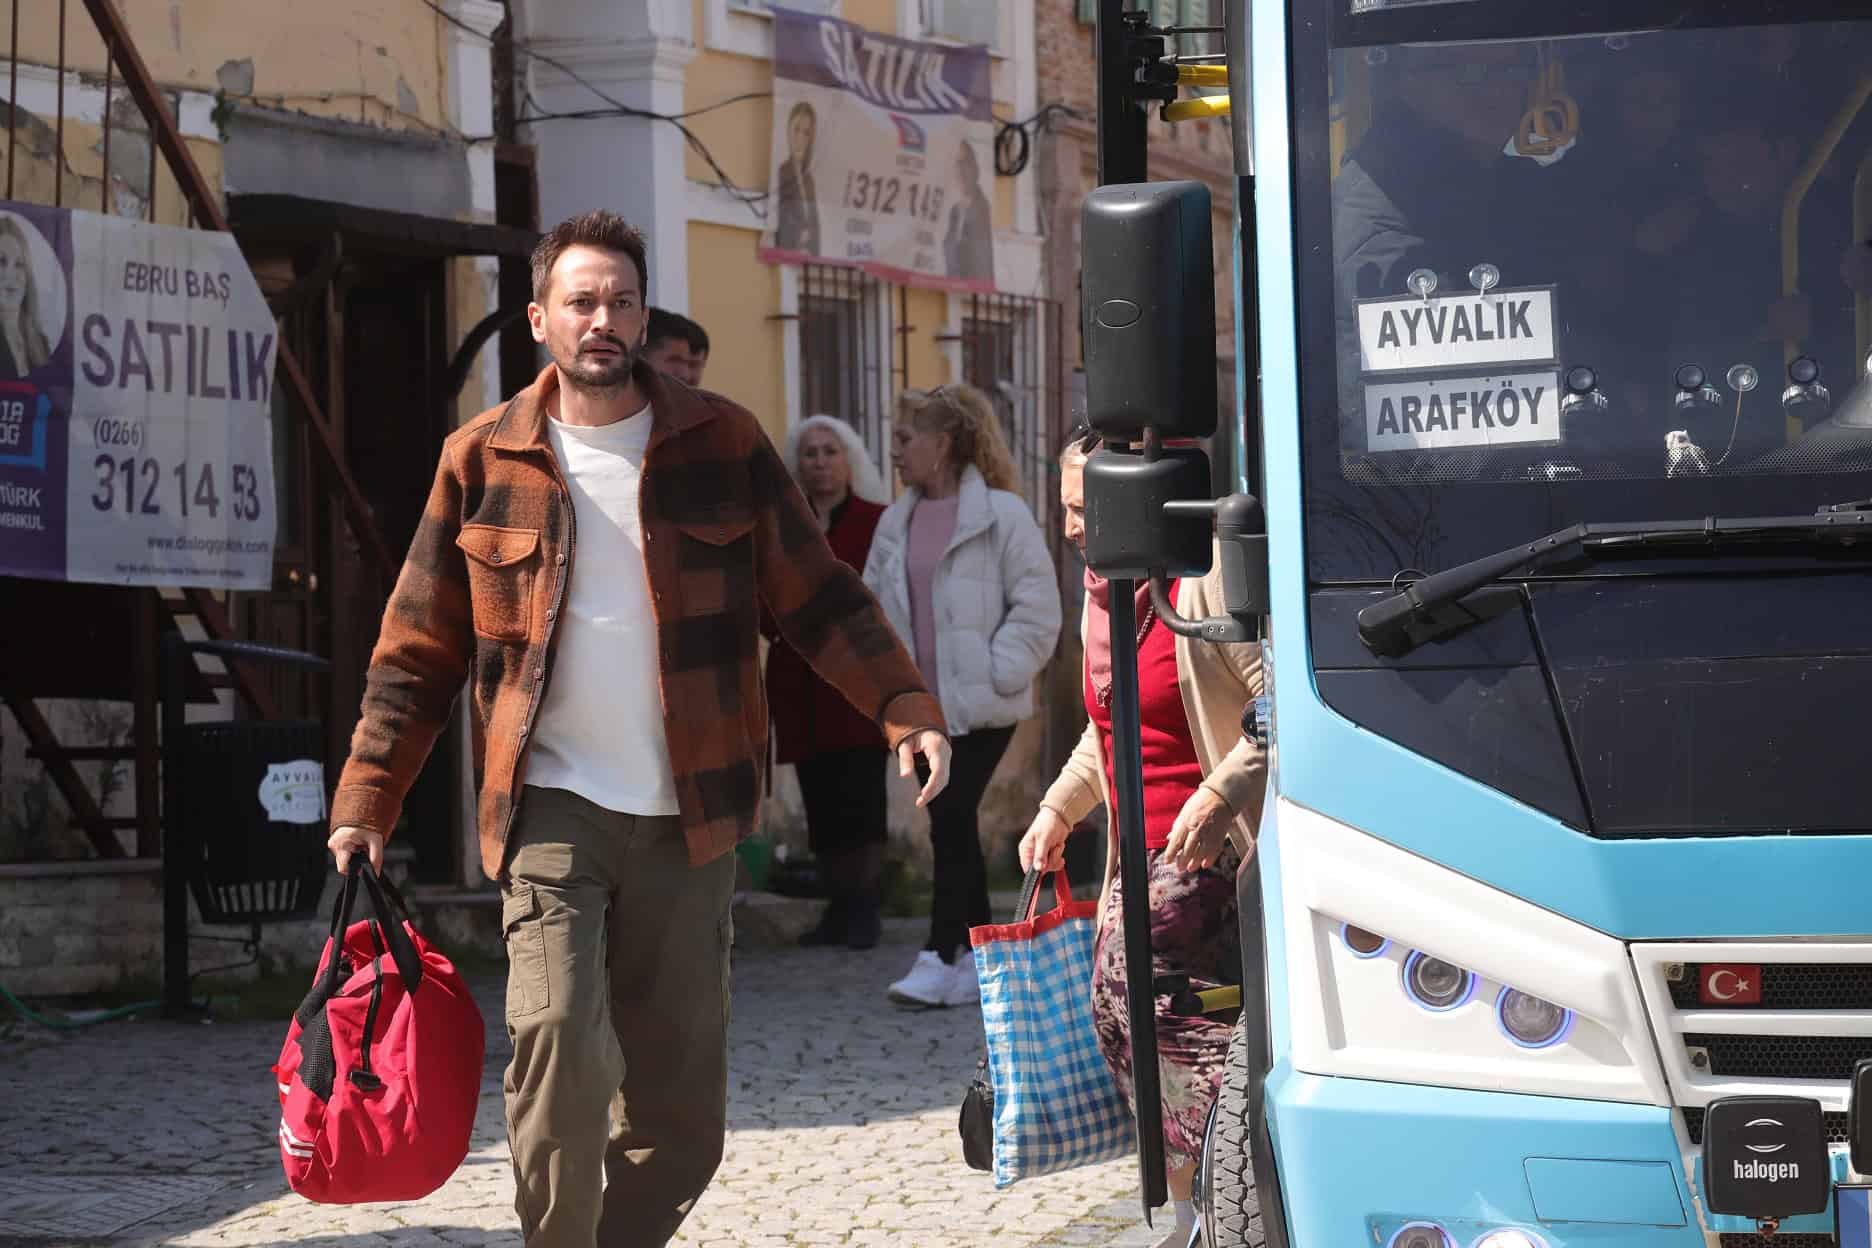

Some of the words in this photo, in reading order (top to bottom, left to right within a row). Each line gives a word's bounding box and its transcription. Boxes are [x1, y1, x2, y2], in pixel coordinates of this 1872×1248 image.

[123, 261, 177, 296] EBRU
[185, 271, 231, 309] BAŞ
[1377, 300, 1533, 349] AYVALIK
[81, 312, 275, 403] SATILIK
[1376, 380, 1544, 436] ARAFKÖY
[94, 417, 145, 451] (0266)
[91, 453, 161, 515] 312
[173, 460, 220, 518] 14
[232, 463, 261, 522] 53
[1733, 1159, 1800, 1182] halogen
